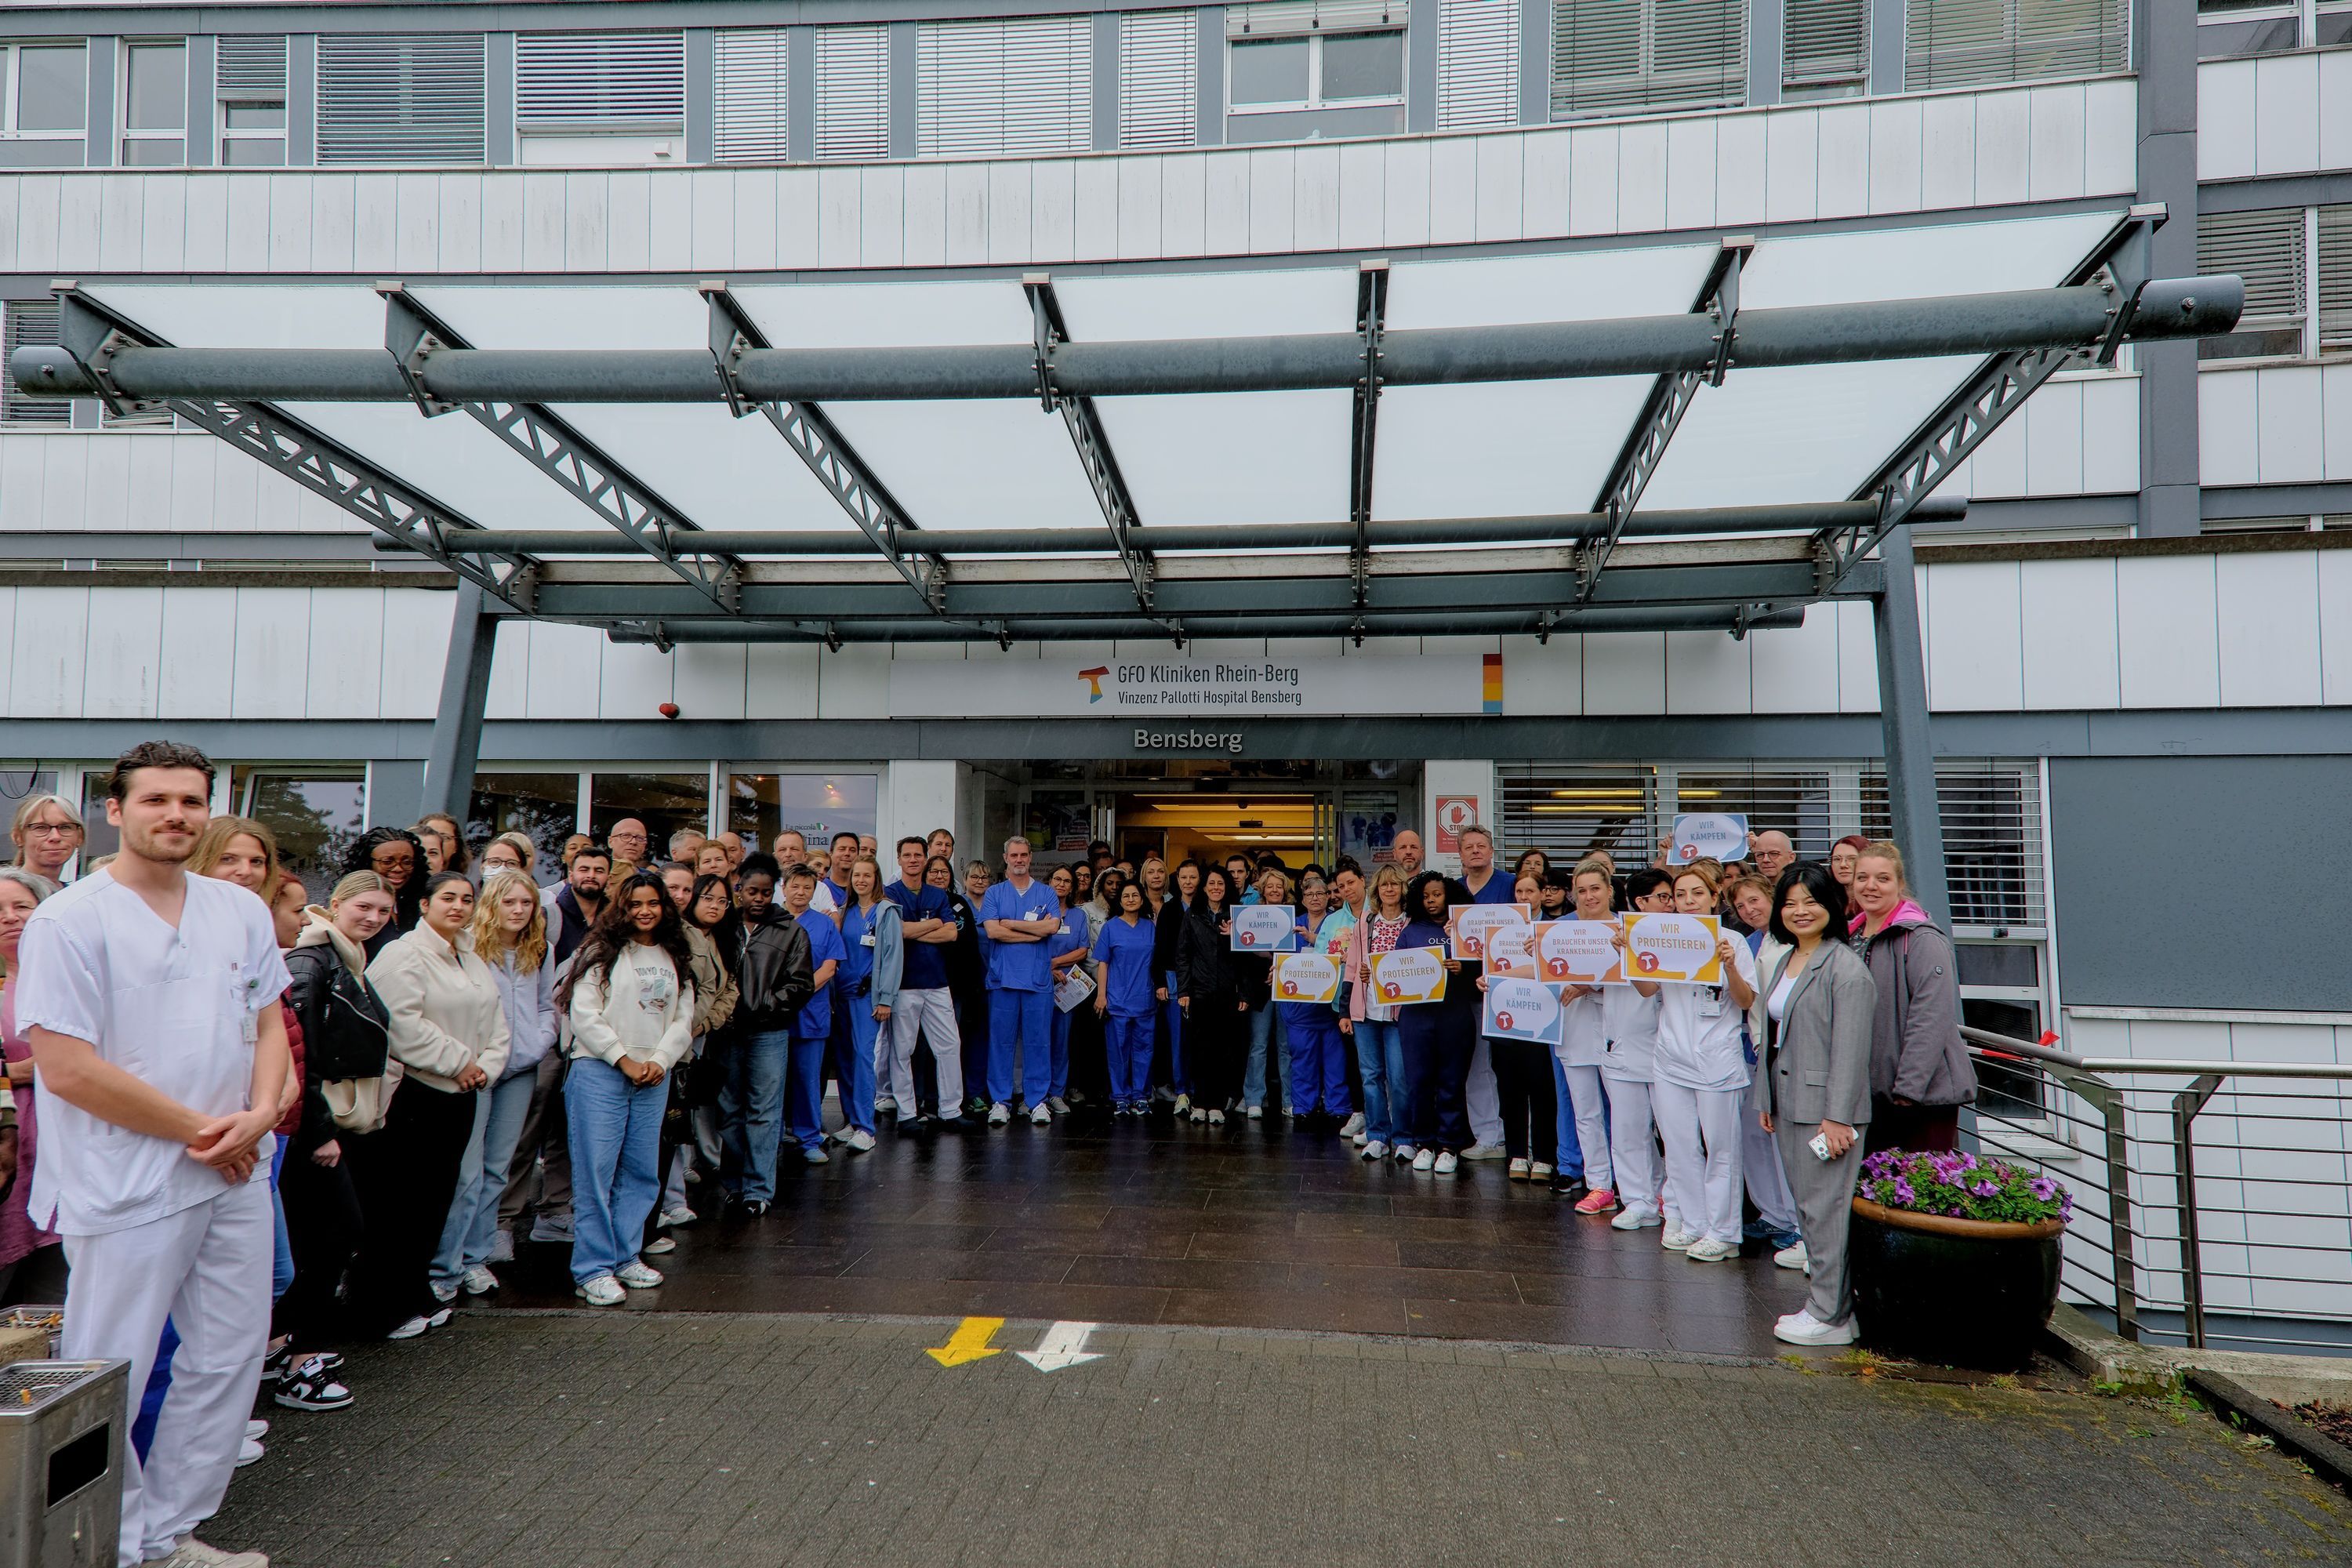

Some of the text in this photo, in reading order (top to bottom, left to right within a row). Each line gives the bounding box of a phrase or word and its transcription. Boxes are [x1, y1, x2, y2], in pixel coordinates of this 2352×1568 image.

[1118, 664, 1299, 686] GFO Kliniken Rhein-Berg
[1118, 689, 1302, 706] Vinzenz Pallotti Hospital Bensberg
[1134, 729, 1243, 753] Bensberg
[1698, 821, 1715, 829] WIR
[1690, 831, 1726, 841] KÄMPFEN
[1256, 911, 1269, 920] WIR
[1248, 920, 1278, 929] KÄMPFEN
[1661, 923, 1680, 934] WIR
[1637, 938, 1706, 950] PROTESTIEREN
[1399, 956, 1414, 965] WIR
[1284, 970, 1330, 979] PROTESTIEREN
[1382, 967, 1436, 979] PROTESTIEREN
[1515, 987, 1531, 996] WIR
[1506, 1000, 1541, 1011] KÄMPFEN
